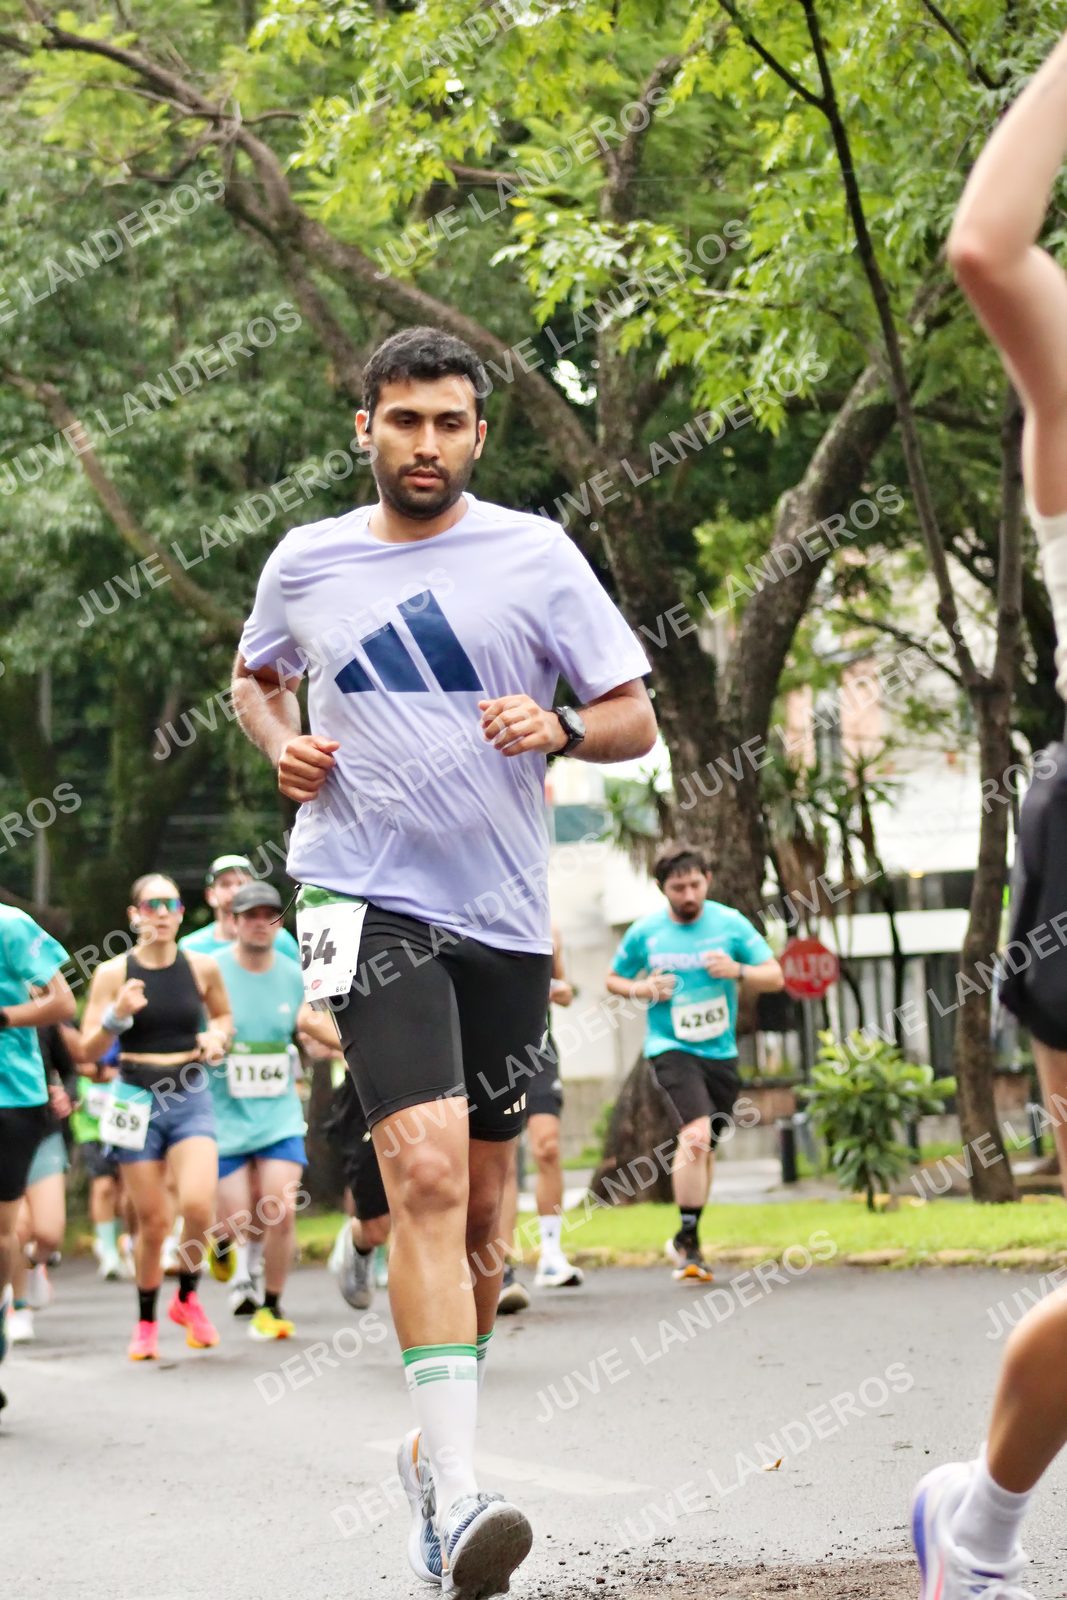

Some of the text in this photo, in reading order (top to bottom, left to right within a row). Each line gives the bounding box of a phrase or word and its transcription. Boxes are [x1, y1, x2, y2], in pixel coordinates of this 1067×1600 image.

[784, 953, 835, 981] ALTO
[680, 1007, 725, 1028] 4263
[235, 1065, 284, 1081] 1164
